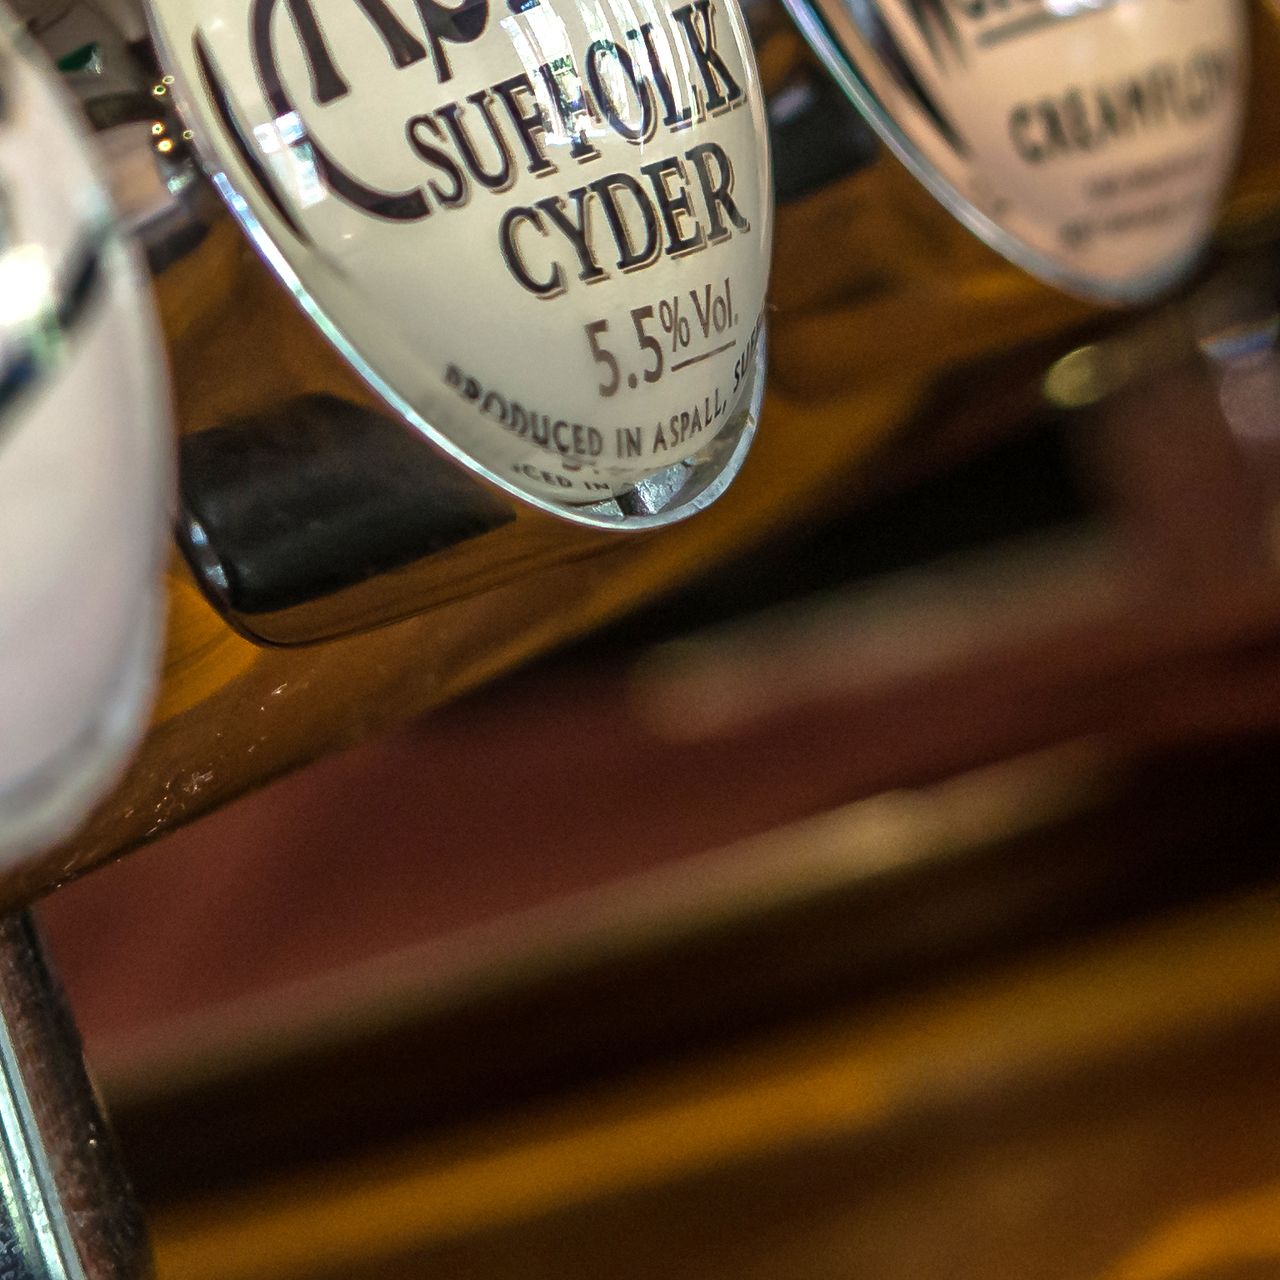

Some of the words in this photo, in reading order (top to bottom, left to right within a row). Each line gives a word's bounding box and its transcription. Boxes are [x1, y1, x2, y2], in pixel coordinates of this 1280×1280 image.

[498, 142, 750, 300] CYDER
[584, 296, 691, 398] 5.5%
[690, 277, 739, 339] Vol.
[616, 425, 643, 458] IN
[652, 387, 727, 454] ASPALL,
